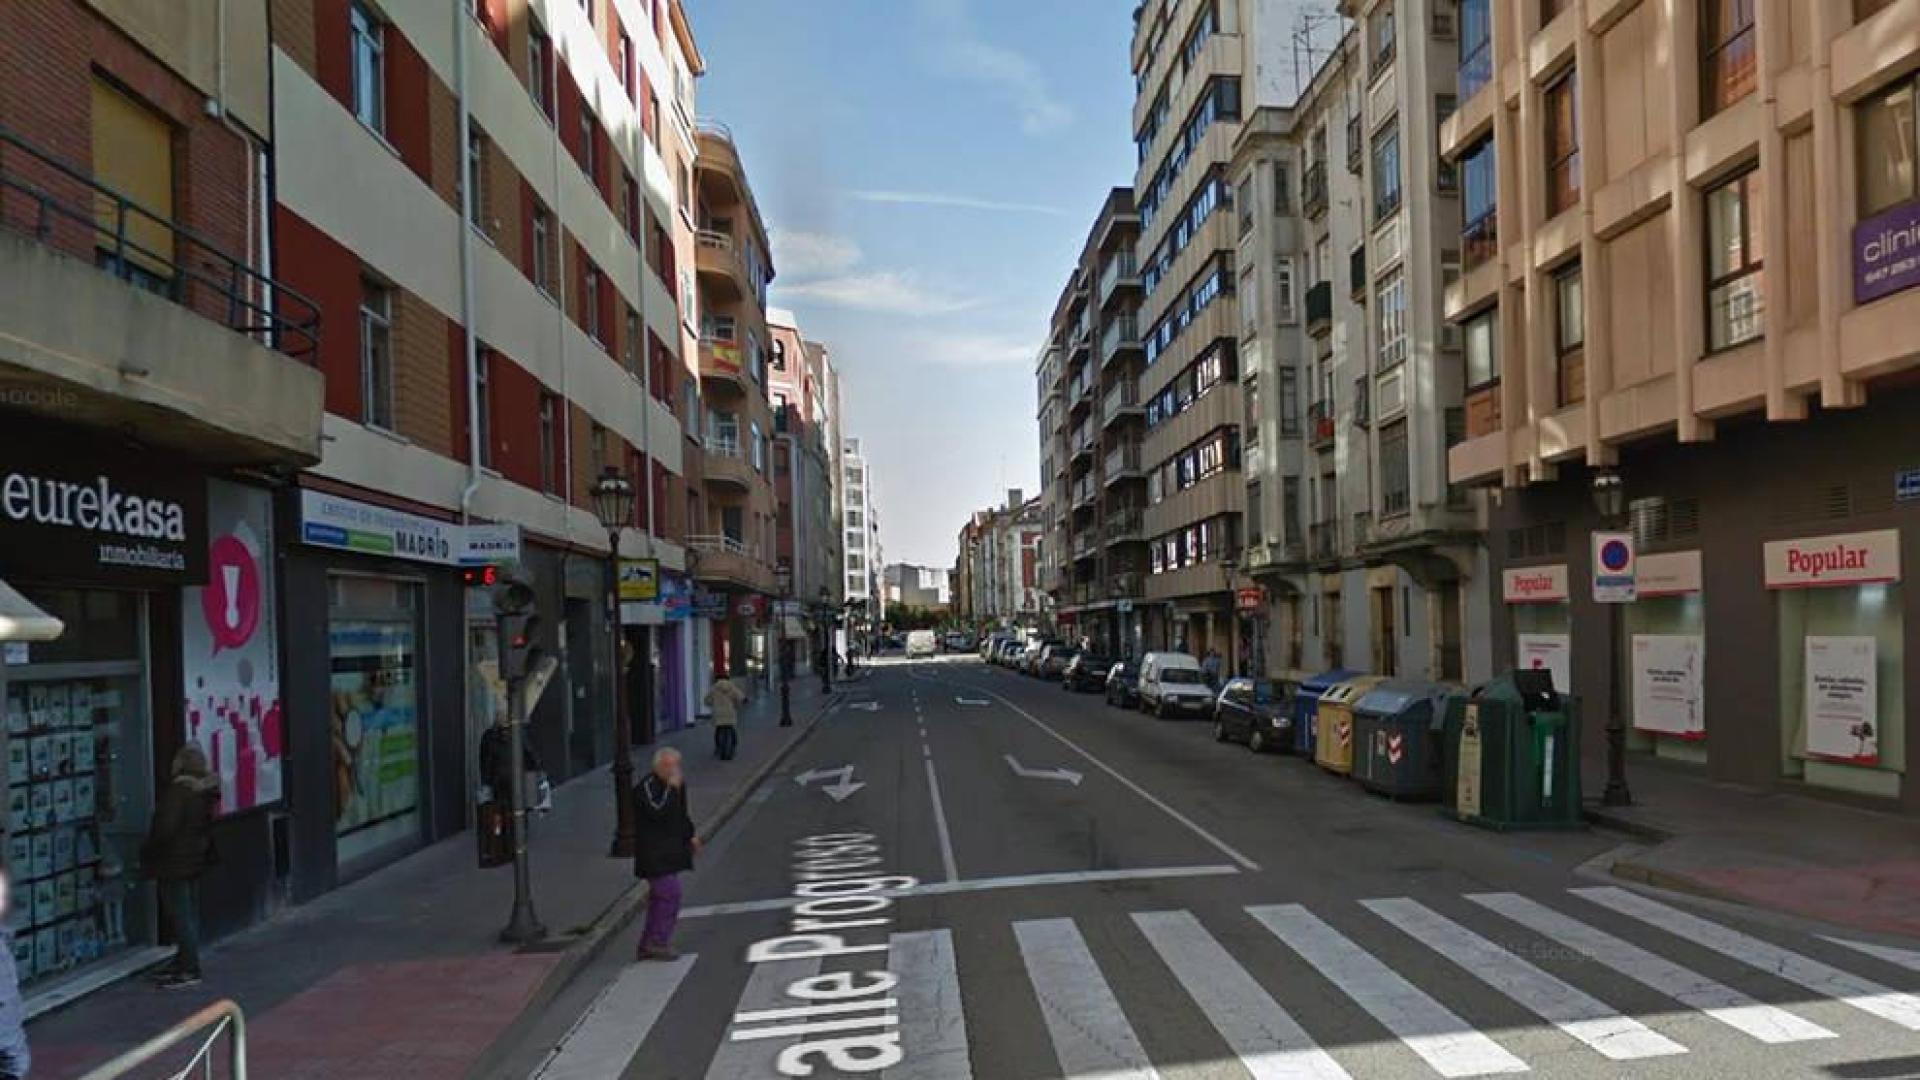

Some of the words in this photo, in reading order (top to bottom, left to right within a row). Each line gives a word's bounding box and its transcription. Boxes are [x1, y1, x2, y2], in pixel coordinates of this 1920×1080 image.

[1864, 219, 1920, 262] clini
[3, 472, 185, 541] eurekasa
[1788, 544, 1869, 575] Popular
[1513, 575, 1554, 596] Popular
